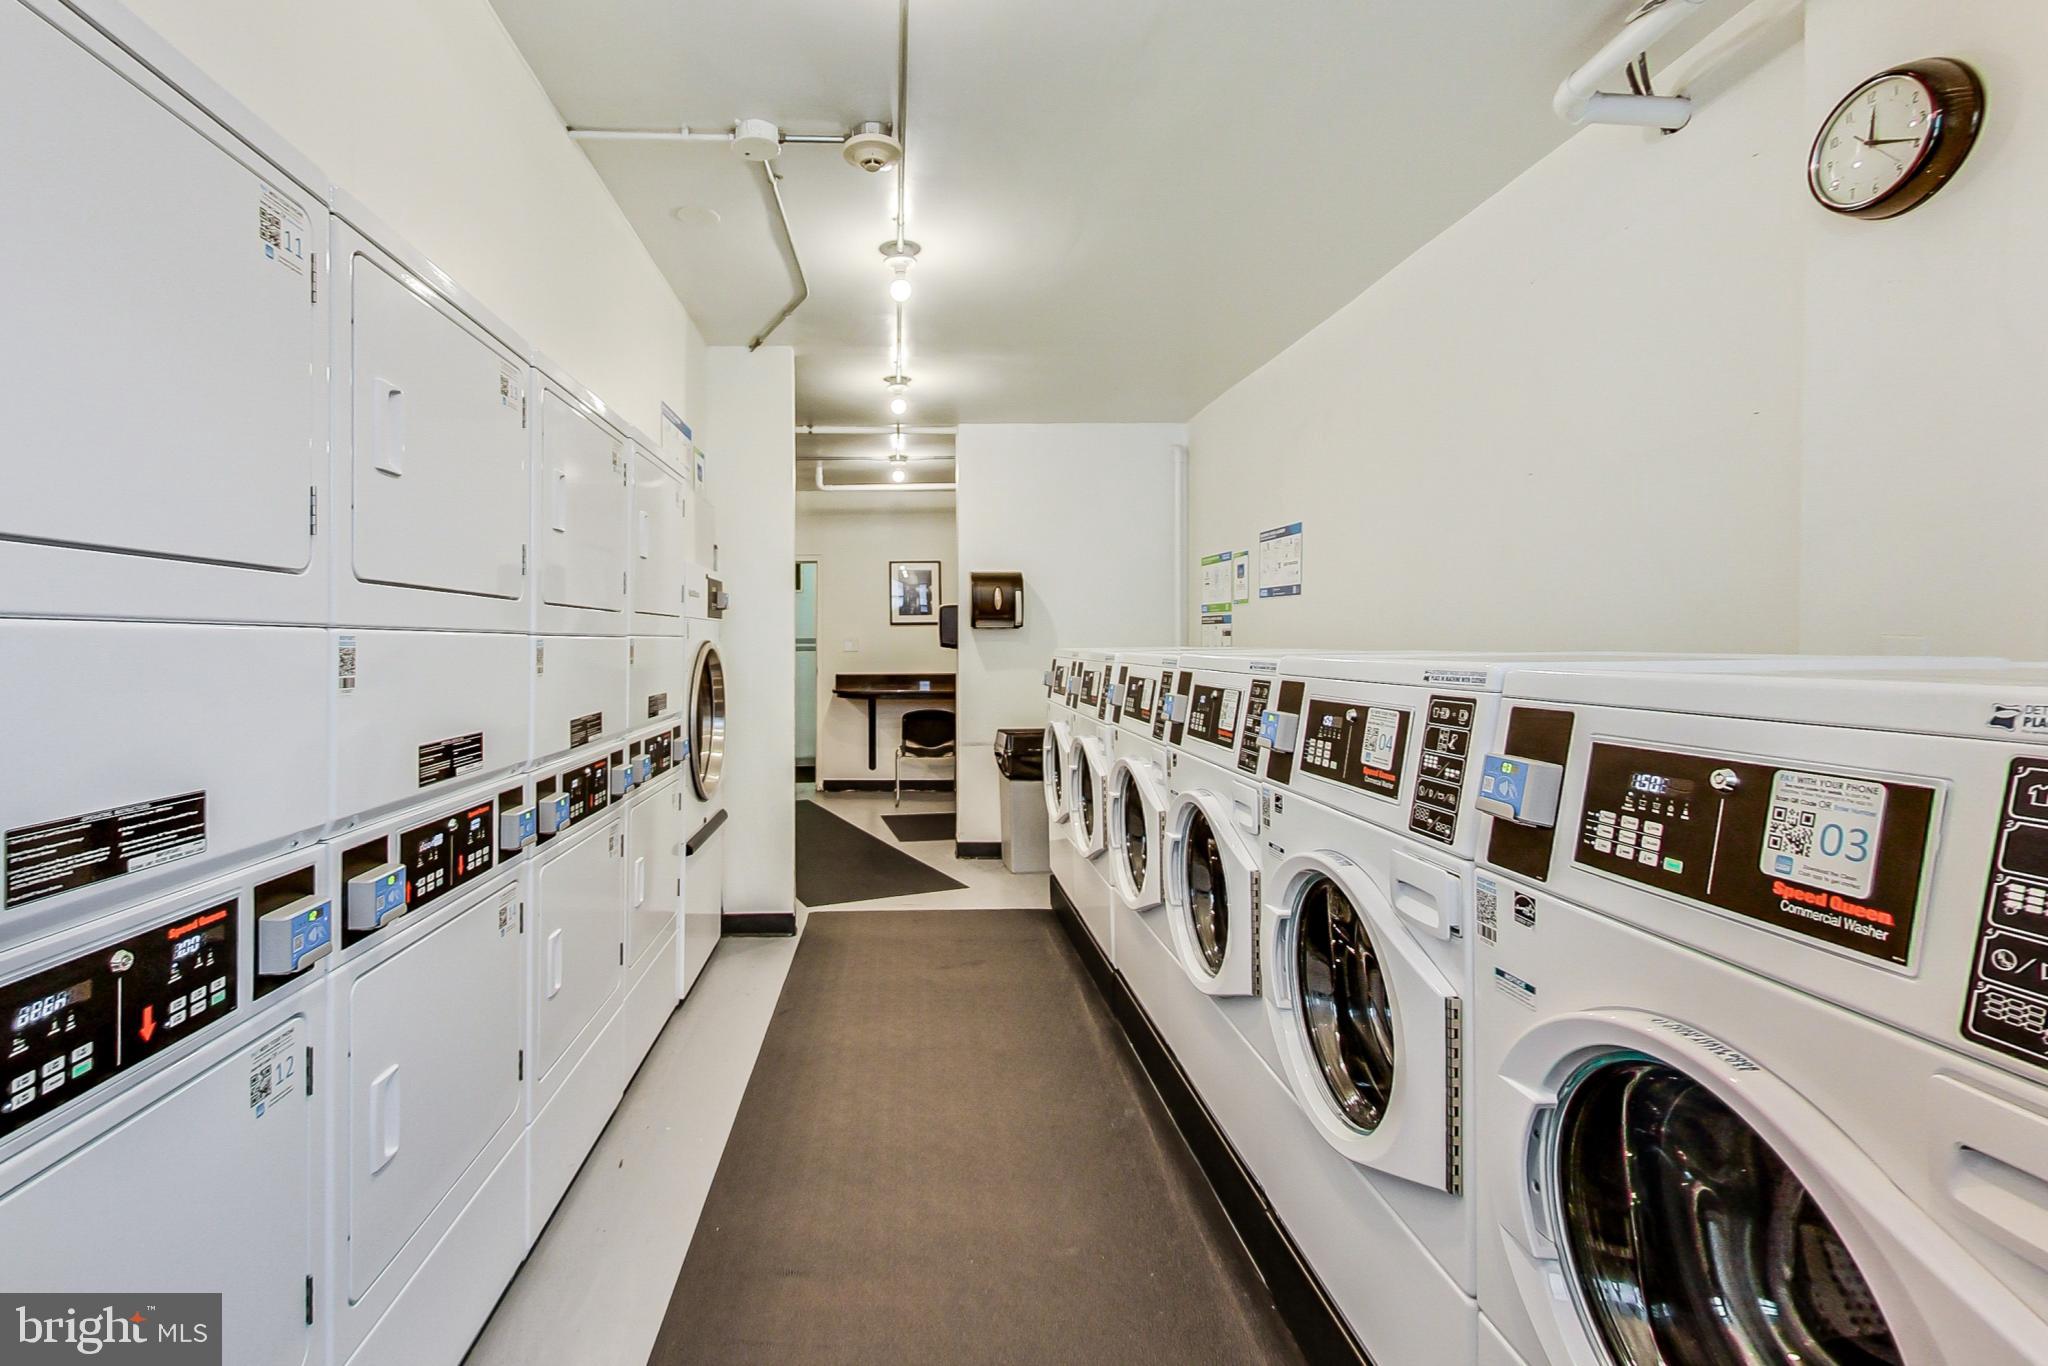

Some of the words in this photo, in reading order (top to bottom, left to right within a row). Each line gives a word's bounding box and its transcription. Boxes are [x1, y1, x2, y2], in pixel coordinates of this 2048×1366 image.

[1379, 734, 1393, 752] 04
[1797, 776, 1817, 786] WITH
[1820, 779, 1843, 790] YOUR
[1846, 782, 1880, 795] PHONE
[1820, 823, 1869, 862] 03
[1772, 880, 1827, 907] Speed
[1829, 895, 1896, 926] Queen
[1780, 899, 1841, 928] Commercial
[1844, 917, 1889, 942] Washer
[275, 1055, 295, 1086] 12
